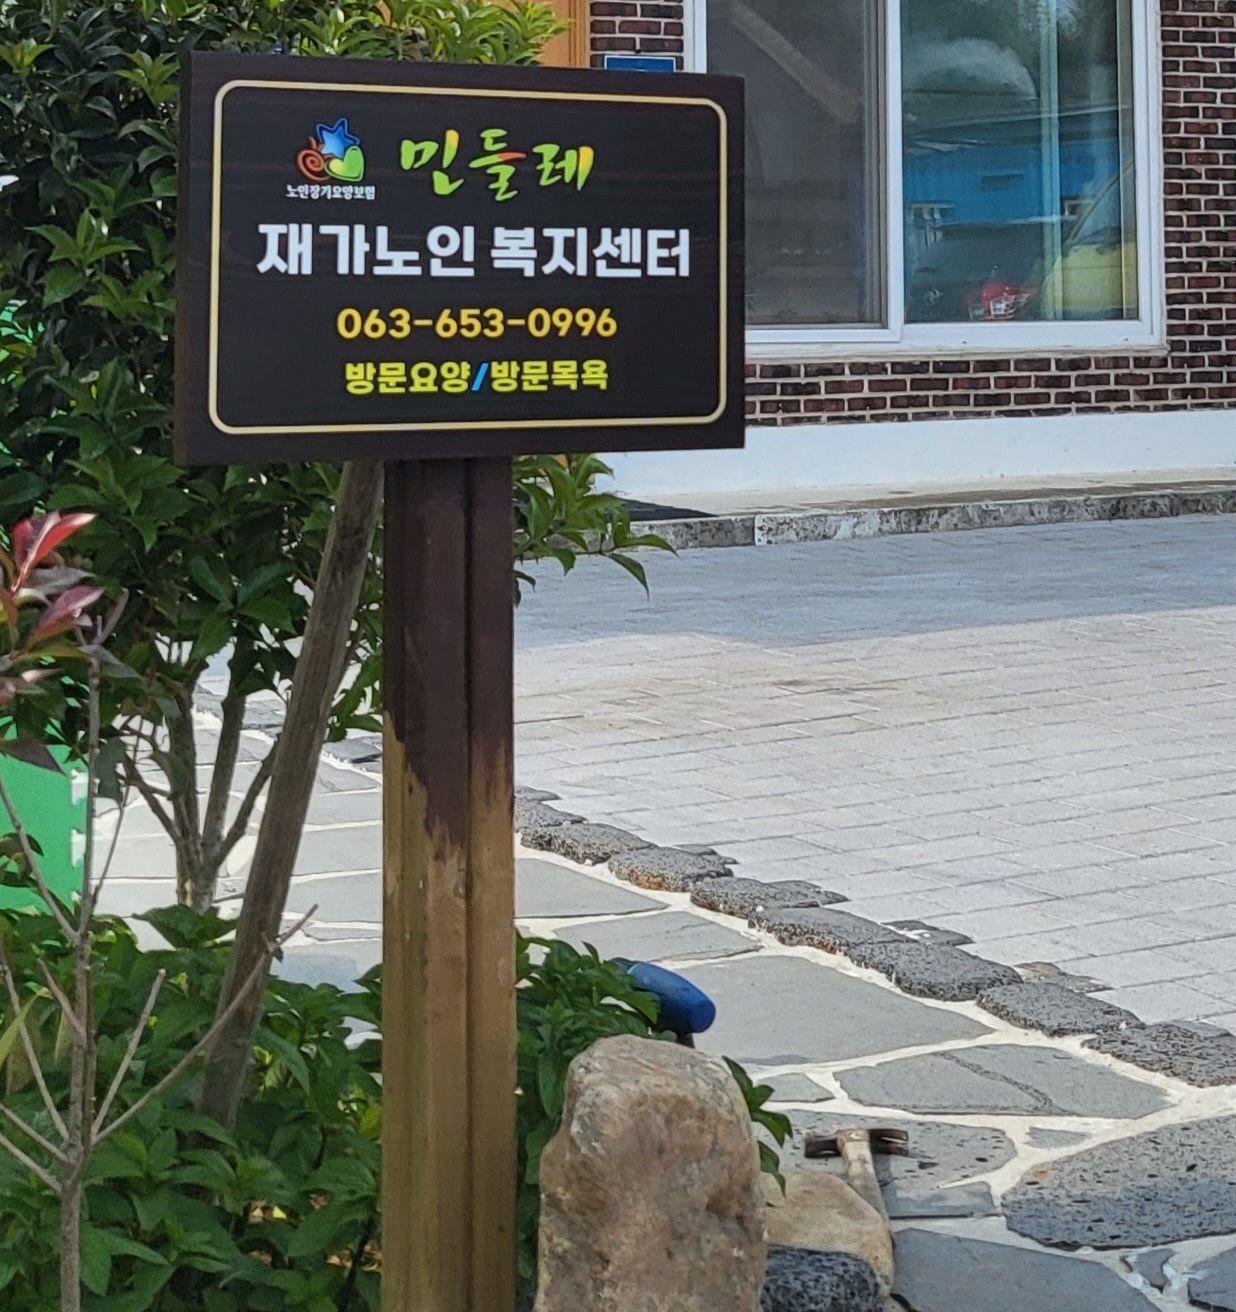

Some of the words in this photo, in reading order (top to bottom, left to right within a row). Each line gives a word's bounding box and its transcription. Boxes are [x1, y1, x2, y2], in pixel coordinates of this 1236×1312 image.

[399, 127, 596, 202] 민들레
[285, 183, 376, 201] 노인장기요양보험
[256, 222, 476, 278] 재가노인
[490, 225, 691, 279] 복지센터
[336, 307, 619, 340] 063-653-0996
